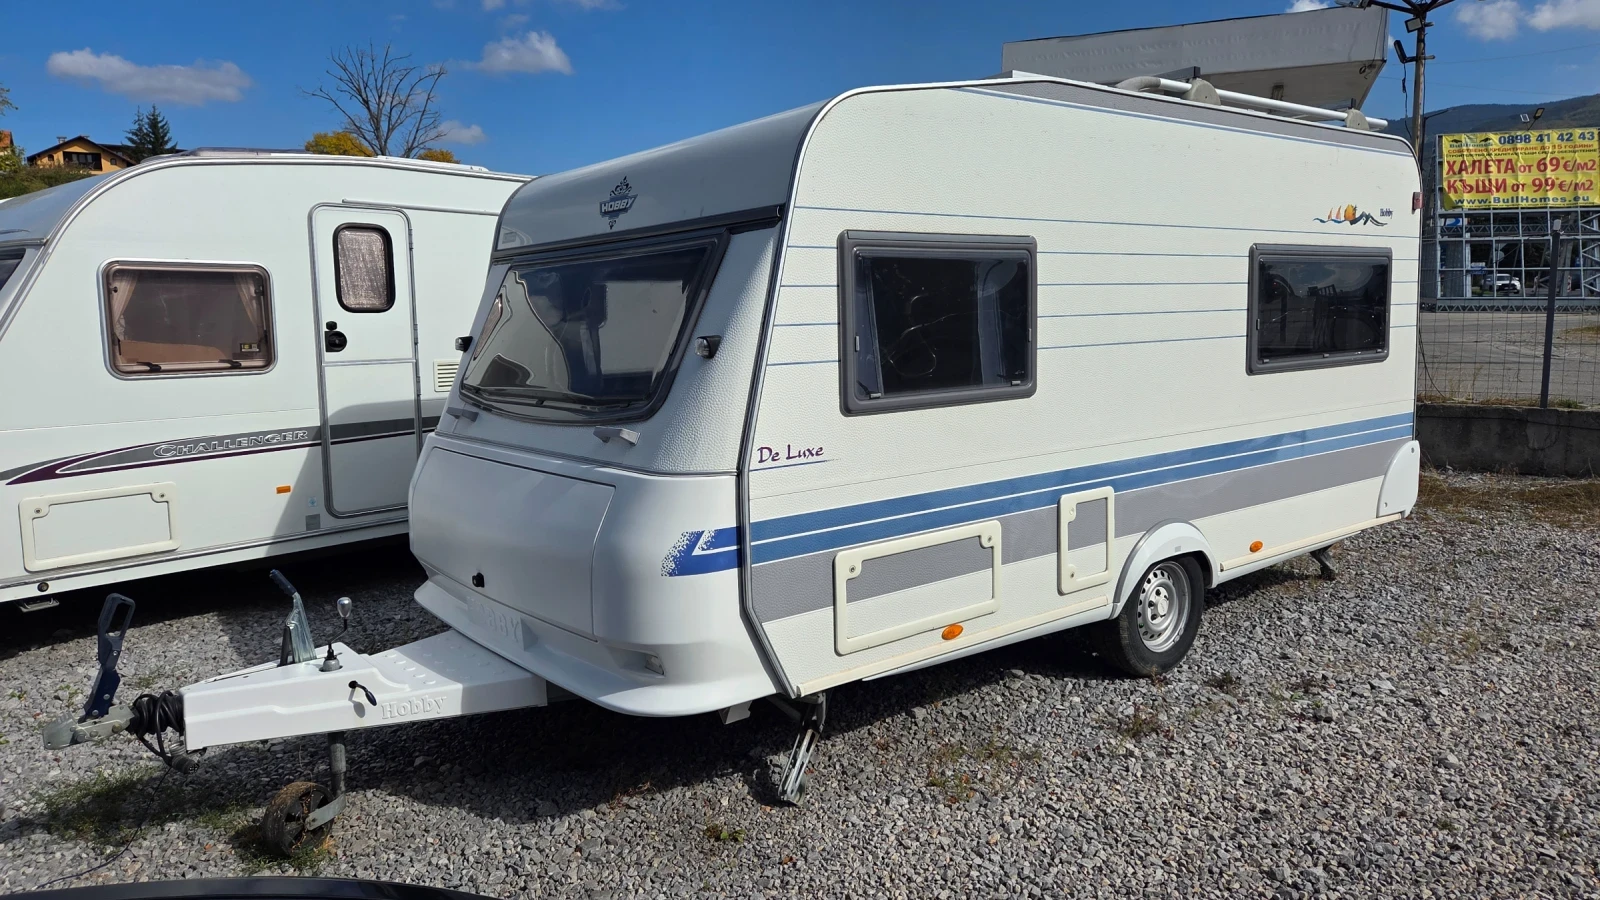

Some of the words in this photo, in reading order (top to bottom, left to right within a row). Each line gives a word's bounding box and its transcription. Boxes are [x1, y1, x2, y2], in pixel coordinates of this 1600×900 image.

[1498, 133, 1532, 145] 0898
[1536, 132, 1551, 143] 41
[1557, 132, 1574, 142] 42
[1578, 131, 1595, 141] 43
[1446, 158, 1516, 175] ХАЛЕТА
[1447, 178, 1507, 196] КЪЩИ
[601, 197, 635, 213] HOBBY
[1454, 195, 1590, 205] www.BullHomes.eu
[153, 430, 308, 458] CHALLENGER
[757, 446, 781, 464] De
[786, 444, 825, 460] Luxe
[380, 694, 448, 720] Hobby
